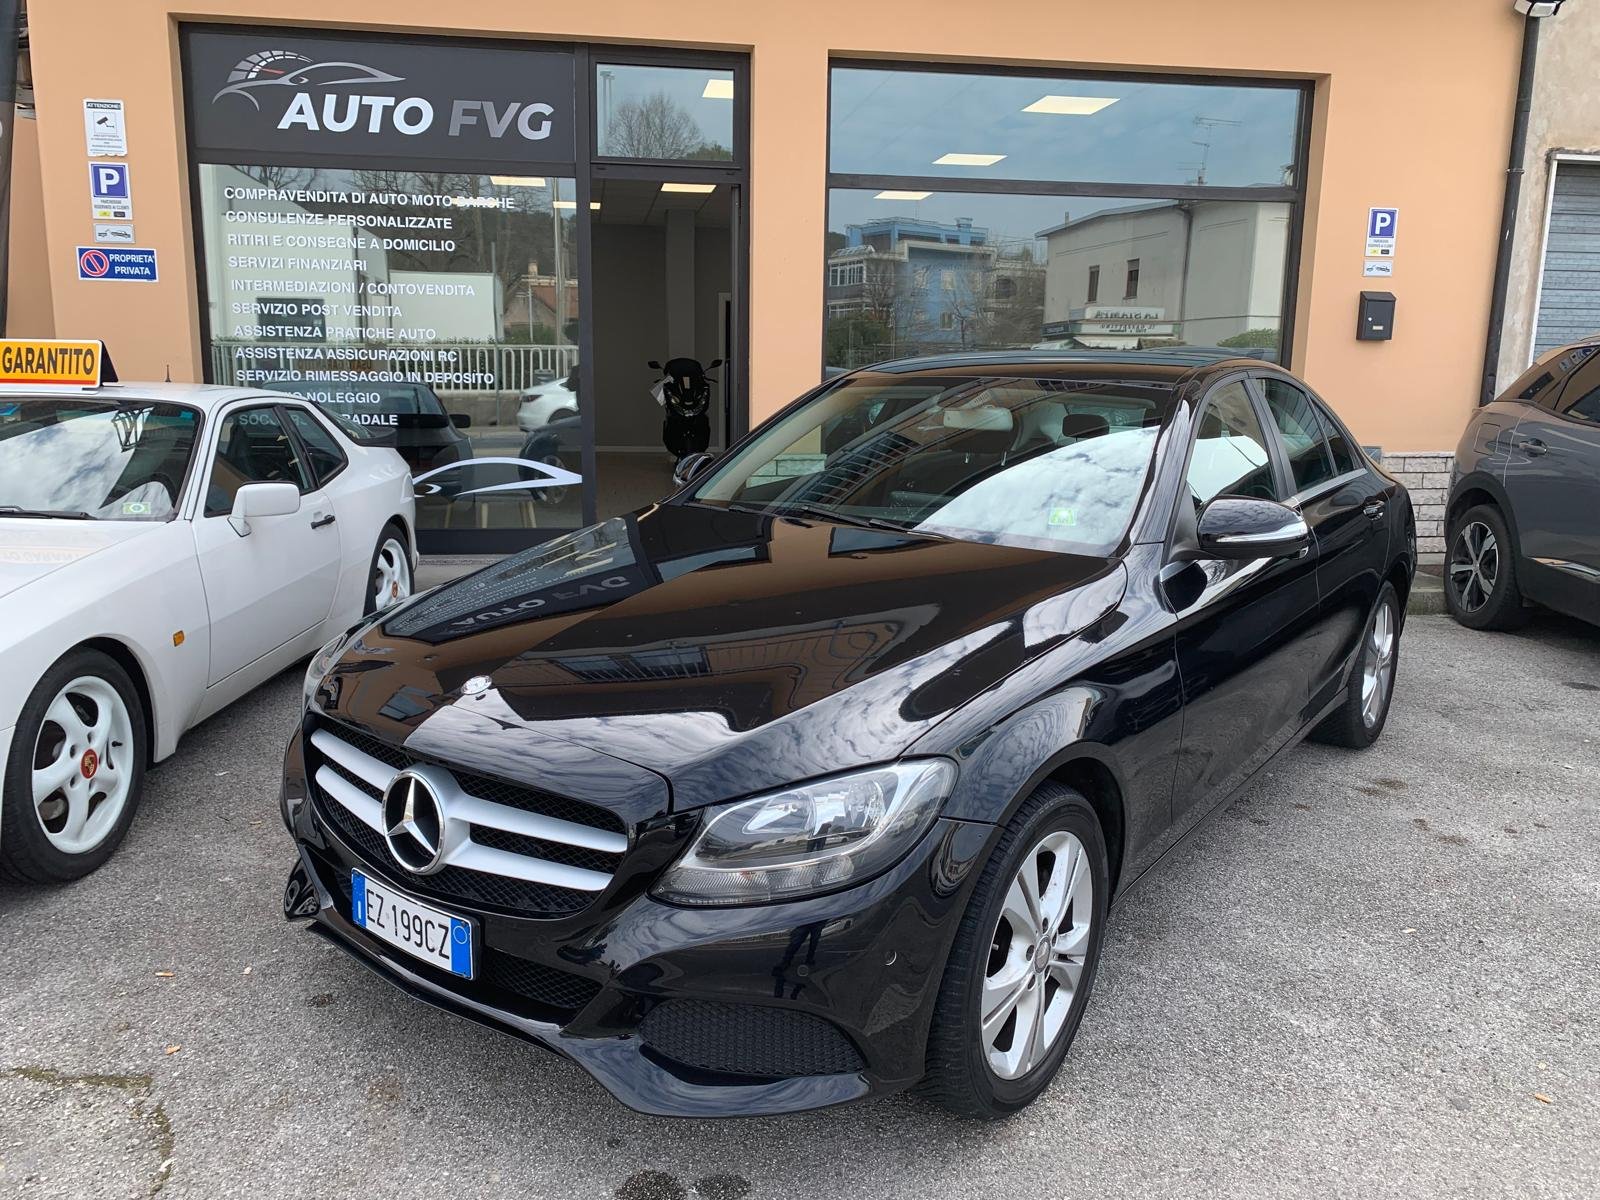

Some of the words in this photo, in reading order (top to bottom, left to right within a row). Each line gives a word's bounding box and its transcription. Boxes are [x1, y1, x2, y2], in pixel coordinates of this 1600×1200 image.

[277, 92, 434, 135] AUTO
[448, 100, 554, 140] FVG
[98, 167, 120, 194] P
[224, 187, 348, 203] COMPRAVENDITA
[351, 192, 366, 204] DI
[369, 193, 408, 205] AUTO
[411, 194, 453, 207] MOTO
[225, 210, 324, 225] CONSULENZE
[328, 214, 453, 229] PERSONALIZZATE
[1374, 212, 1391, 235] P
[227, 233, 269, 246] RITIRI
[272, 235, 283, 247] E
[286, 235, 367, 249] CONSEGNE
[369, 238, 380, 249] A
[383, 238, 456, 252] DOMICILIO
[114, 266, 151, 275] PRIVATA
[228, 256, 284, 269] SERVIZI
[288, 257, 367, 271] FINANZIARI
[230, 279, 355, 293] INTERMEDIAZIONI
[367, 282, 475, 296] CONTOVENDITA
[231, 302, 298, 315] SERVIZIO
[301, 303, 339, 316] POST
[343, 305, 402, 317] VENDITA
[234, 325, 323, 338] ASSISTENZA
[325, 326, 395, 339] PRATICHE
[398, 328, 436, 340] AUTO
[2, 346, 95, 376] GARANTITO
[235, 347, 324, 360] ASSISTENZA
[326, 348, 434, 361] ASSICURAZIONI
[438, 350, 458, 362] RC
[236, 369, 301, 382] SERVIZIO
[305, 370, 404, 382] RIMESSAGGIO
[407, 371, 421, 383] IN
[424, 372, 495, 384] DEPOSITO
[306, 391, 381, 404] NOLEGGIO
[366, 889, 385, 929] EZ
